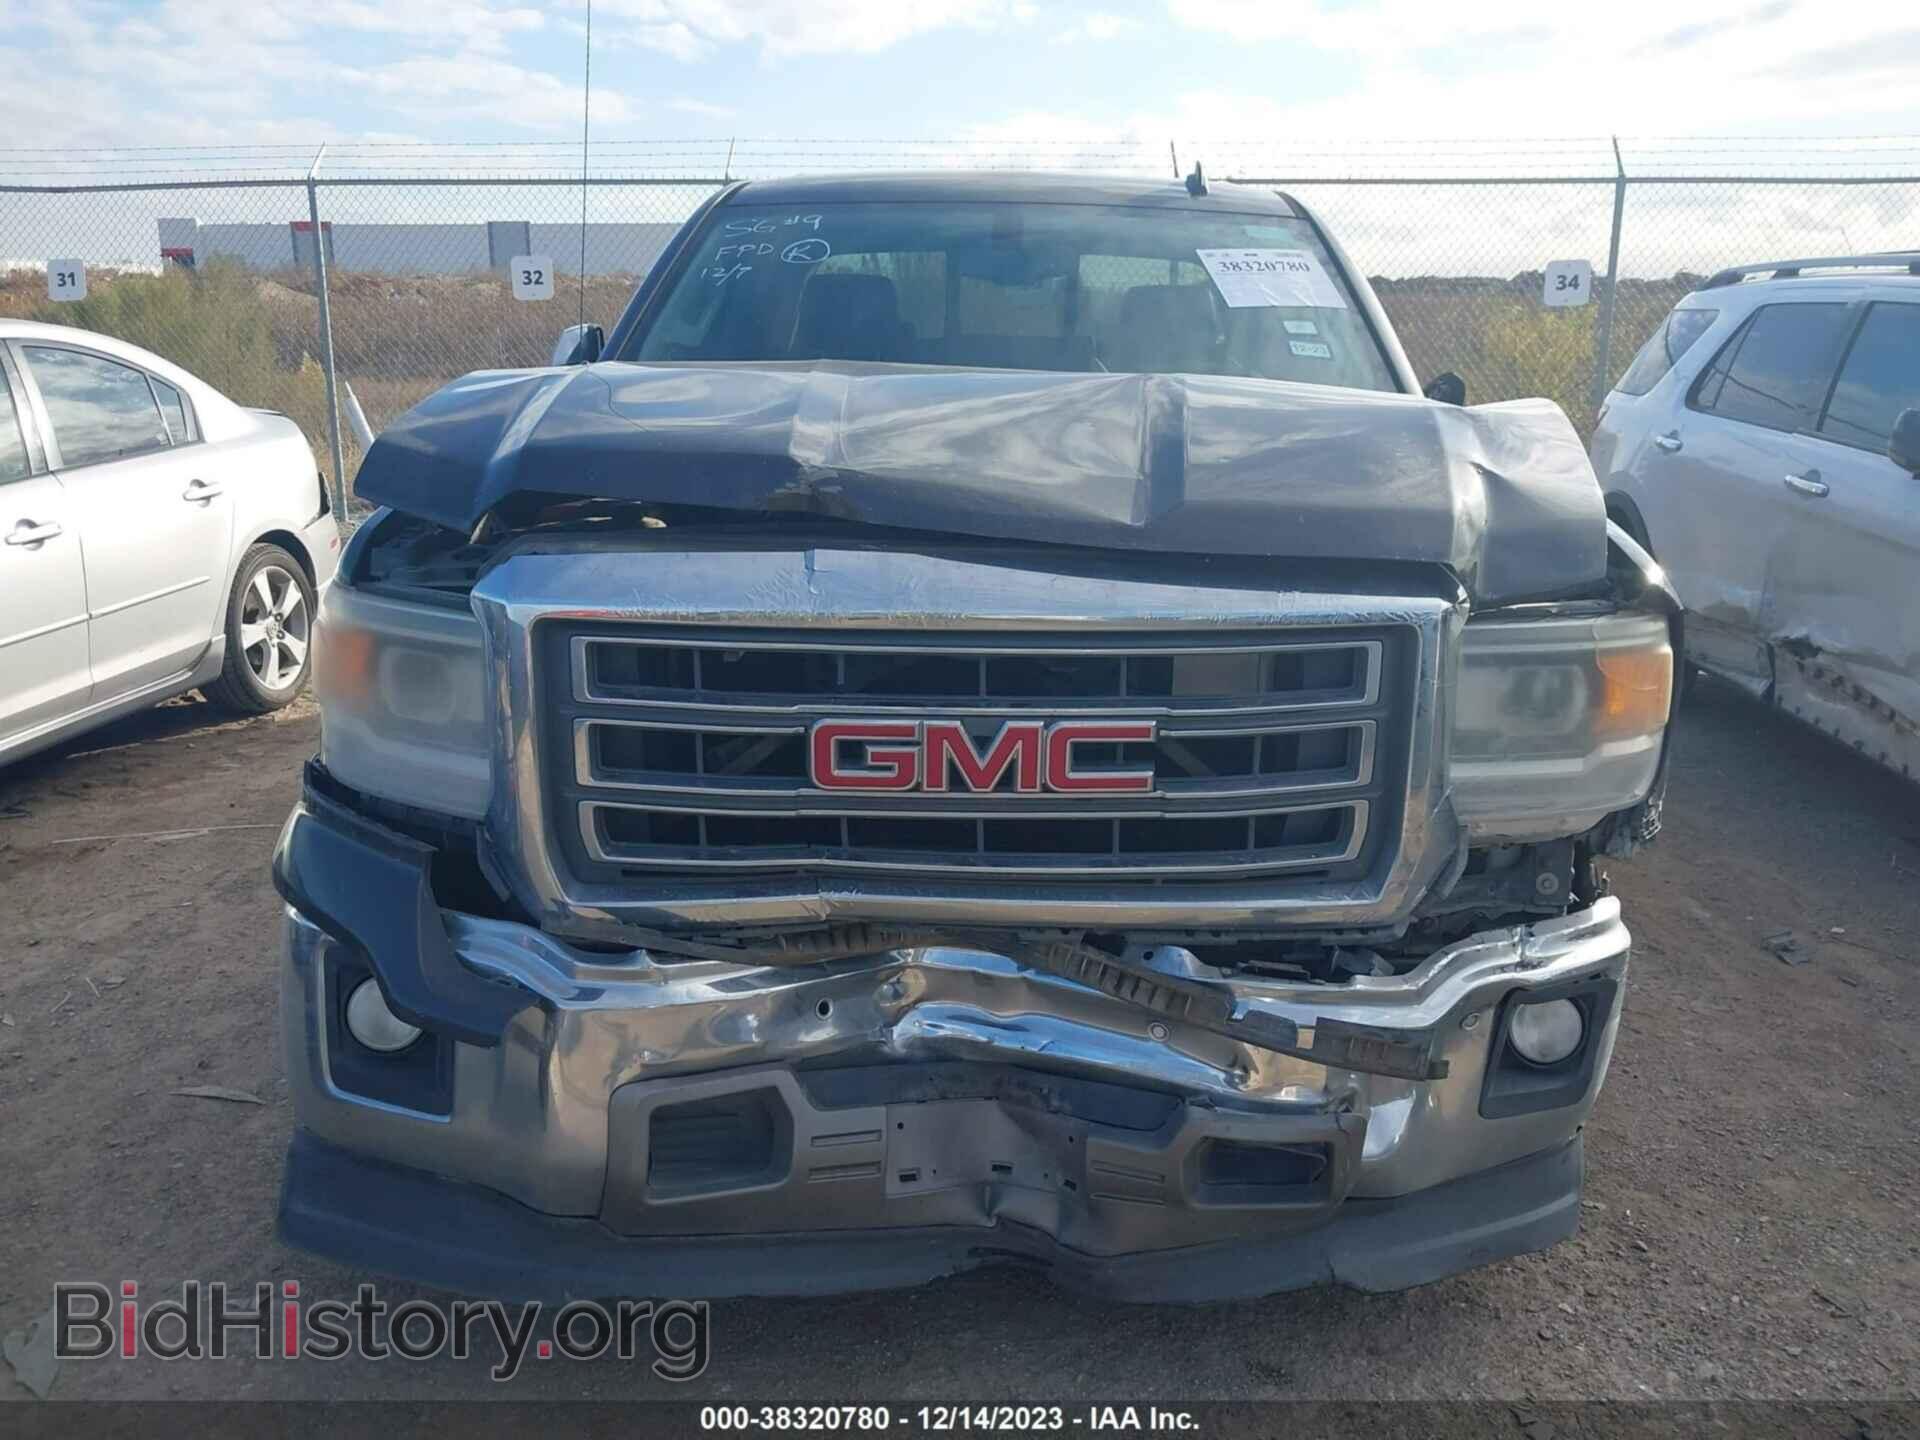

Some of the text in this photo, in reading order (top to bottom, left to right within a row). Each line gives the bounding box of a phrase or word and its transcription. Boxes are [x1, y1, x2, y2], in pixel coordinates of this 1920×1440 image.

[1217, 260, 1312, 273] 38320780
[56, 271, 76, 287] 31
[522, 270, 544, 286] 32
[1555, 274, 1580, 290] 34
[810, 718, 1157, 793] GMC
